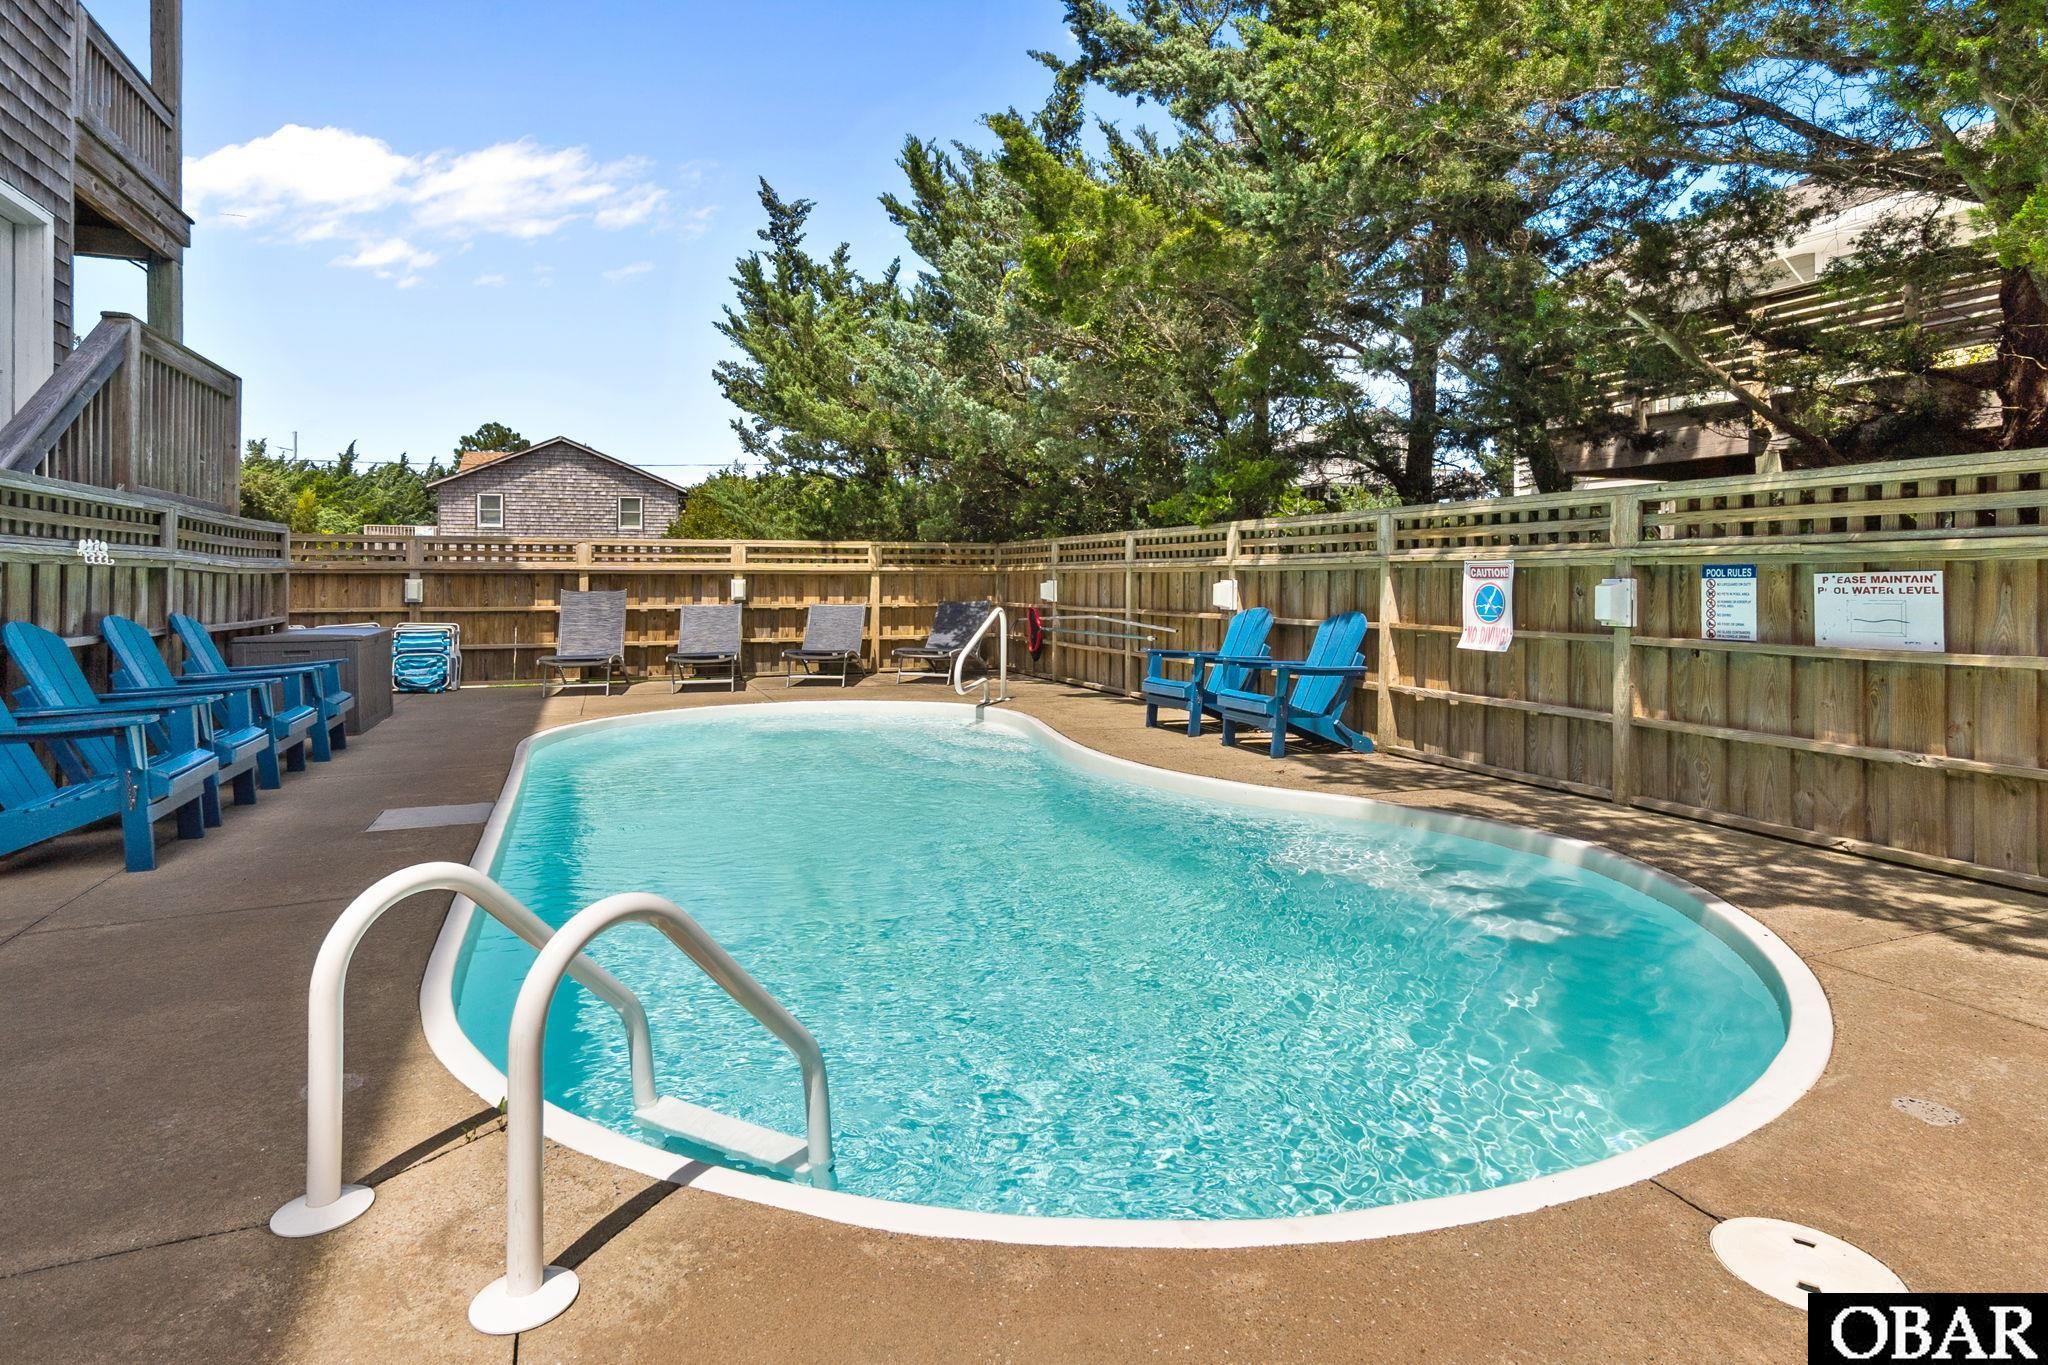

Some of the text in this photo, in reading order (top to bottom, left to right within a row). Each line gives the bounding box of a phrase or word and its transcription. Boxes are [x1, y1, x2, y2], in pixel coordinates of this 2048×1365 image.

[1470, 568, 1509, 578] CAUTION!
[1706, 568, 1752, 578] POOL RULES
[1822, 575, 1933, 584] PEASE MAINTAIN
[1817, 586, 1939, 595] POL WATER LEVEL
